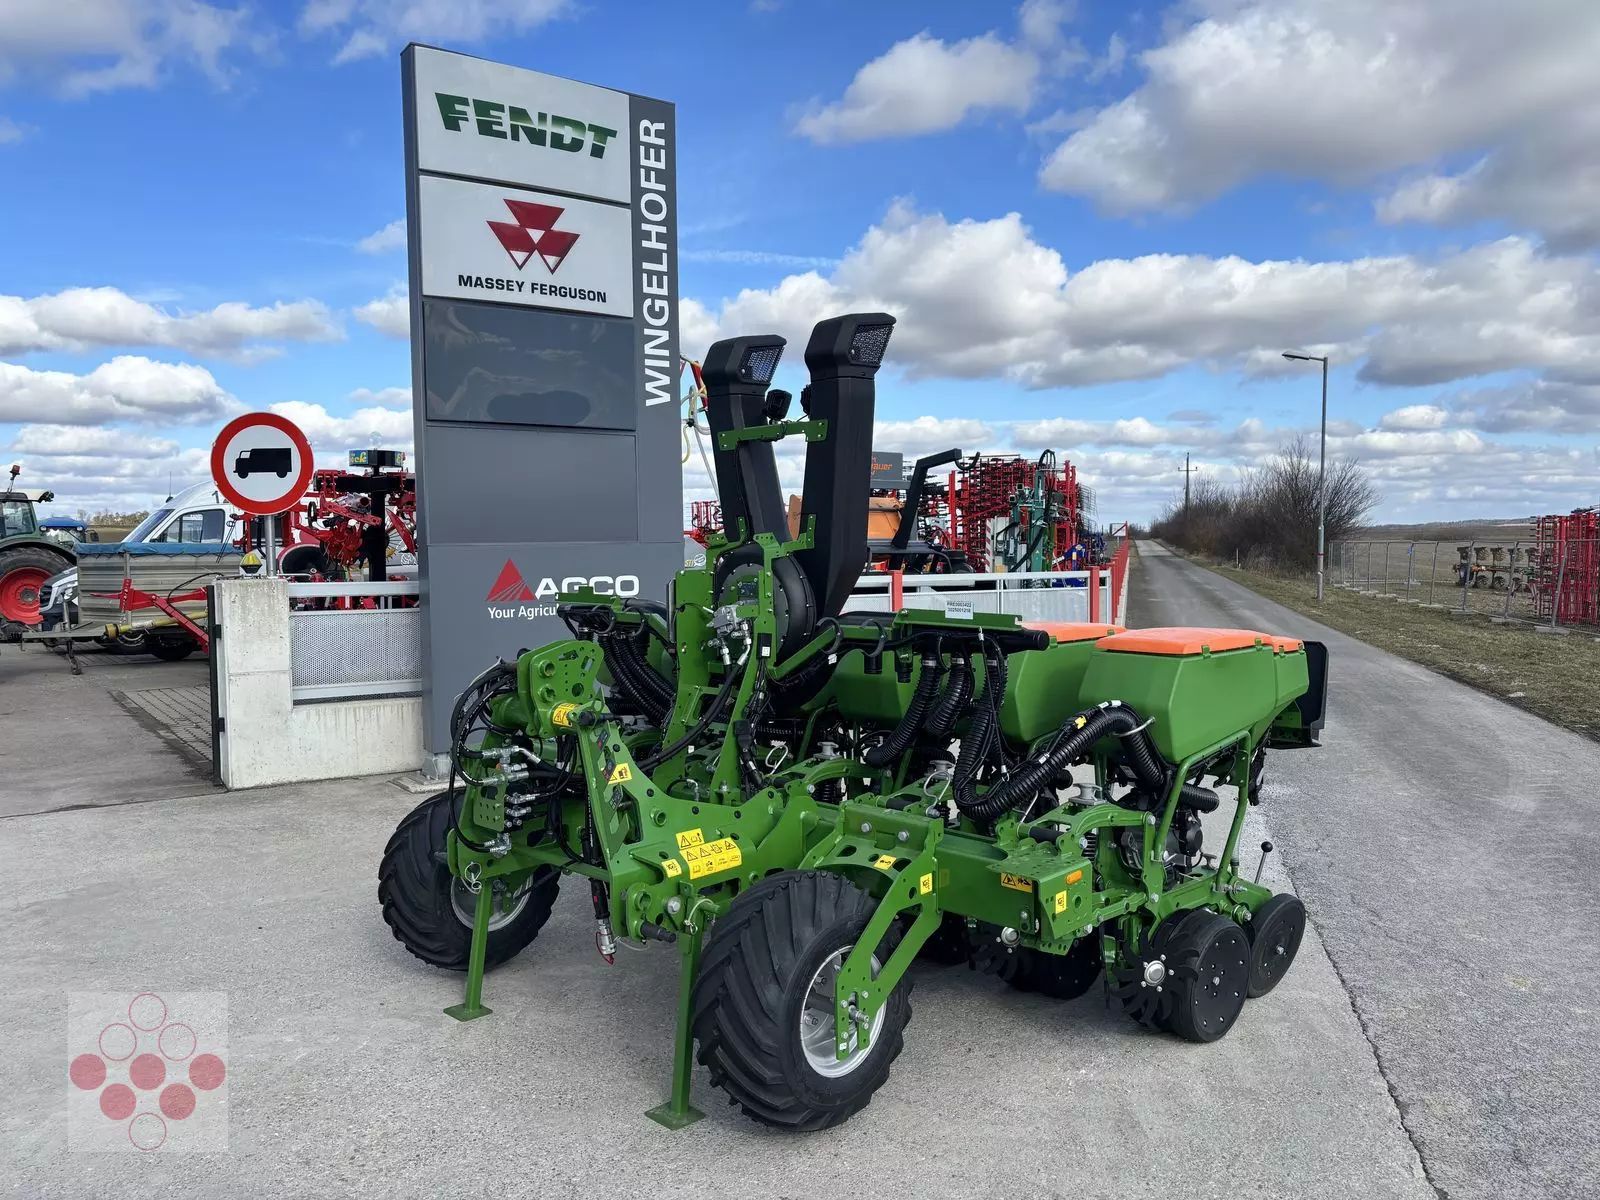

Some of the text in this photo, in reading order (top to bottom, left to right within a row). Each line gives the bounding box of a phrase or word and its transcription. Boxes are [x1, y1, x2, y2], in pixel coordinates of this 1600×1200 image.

[434, 92, 618, 159] FENDT
[639, 119, 671, 407] WINGELHOFER
[458, 274, 607, 303] MASSEY FERGUSON
[534, 575, 640, 600] AGCO
[488, 607, 515, 619] Your
